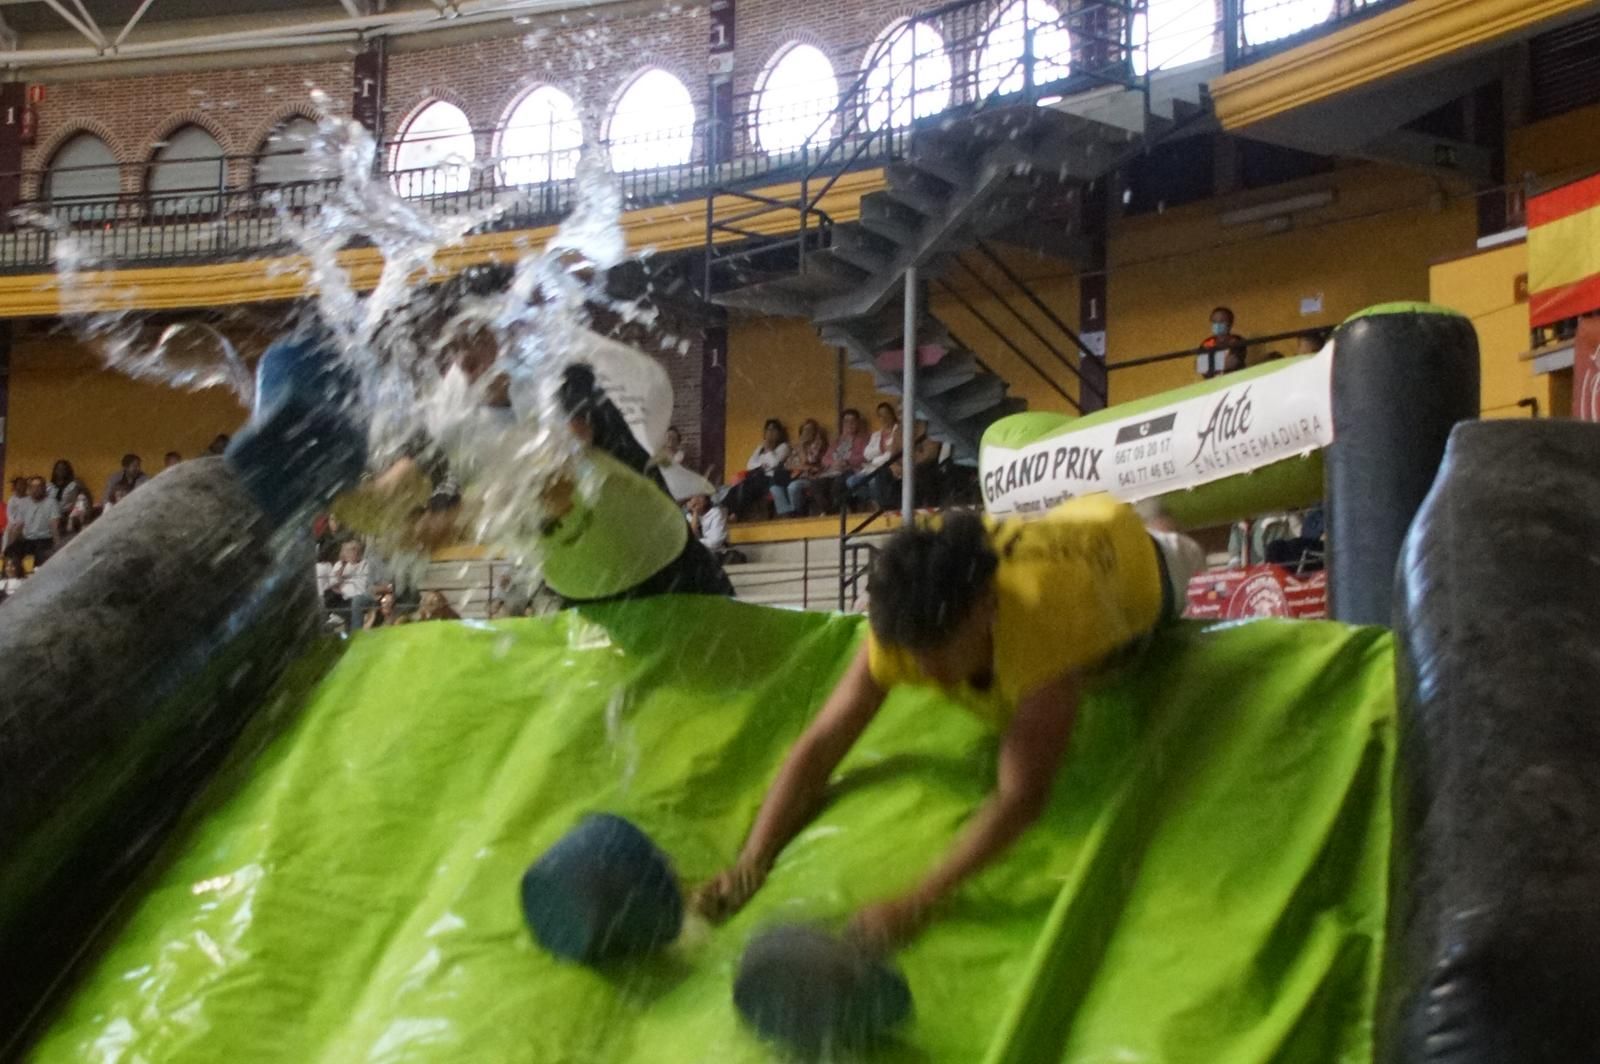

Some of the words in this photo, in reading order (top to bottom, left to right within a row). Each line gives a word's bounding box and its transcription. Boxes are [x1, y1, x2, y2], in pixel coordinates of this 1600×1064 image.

[6, 107, 14, 124] 1
[1089, 298, 1098, 319] 1
[985, 451, 1049, 503] GRAND
[1052, 446, 1103, 480] PRIX
